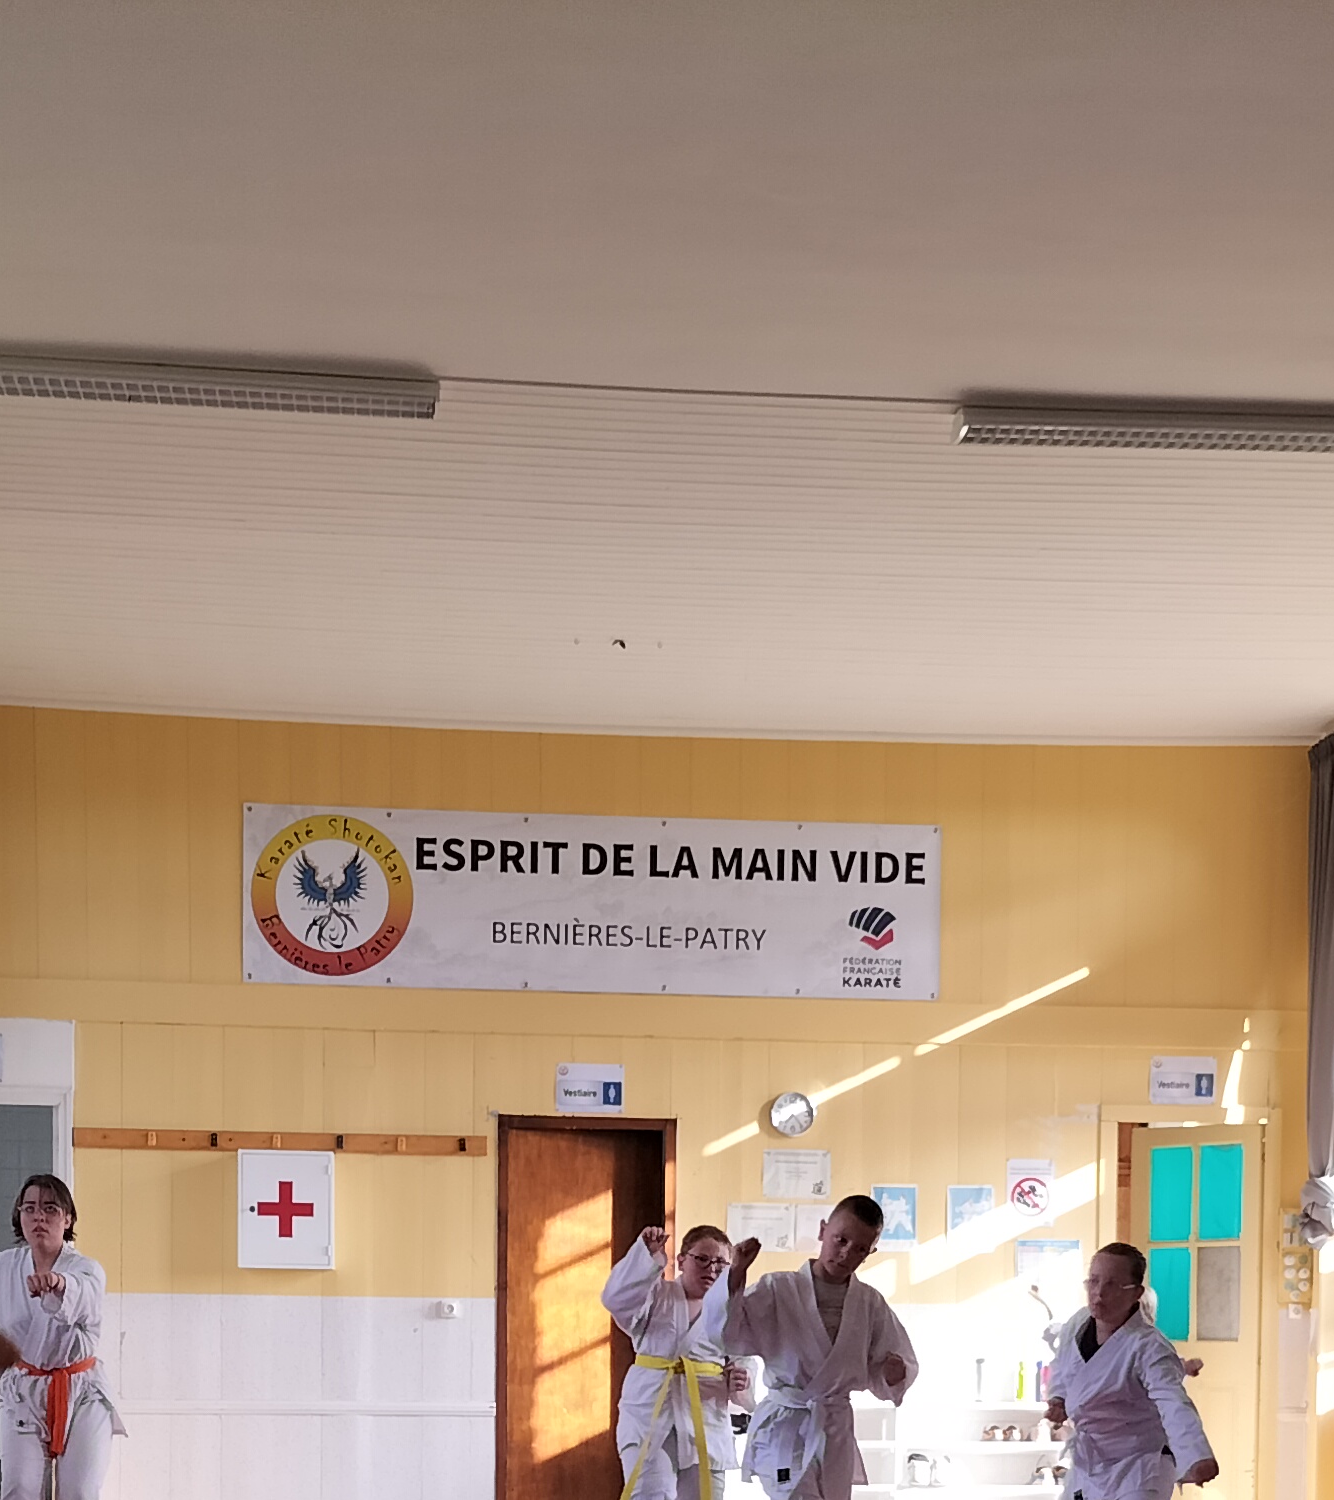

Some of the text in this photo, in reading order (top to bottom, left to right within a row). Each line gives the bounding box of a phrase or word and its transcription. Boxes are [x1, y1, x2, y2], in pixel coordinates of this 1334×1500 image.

[256, 818, 402, 885] Karaté Shotokan
[416, 837, 926, 885] ESPRIT DE LA MAIN VIDE
[492, 917, 767, 951] BERNIÈRES-LE-PATRY
[260, 914, 400, 975] Bernières le Patry
[842, 956, 902, 966] FÉDÉRATION
[842, 966, 901, 976] FRANÇAISE
[842, 976, 902, 988] KARATÉ
[1157, 1080, 1190, 1089] Vestiaire
[563, 1088, 597, 1097] Vestiaire
